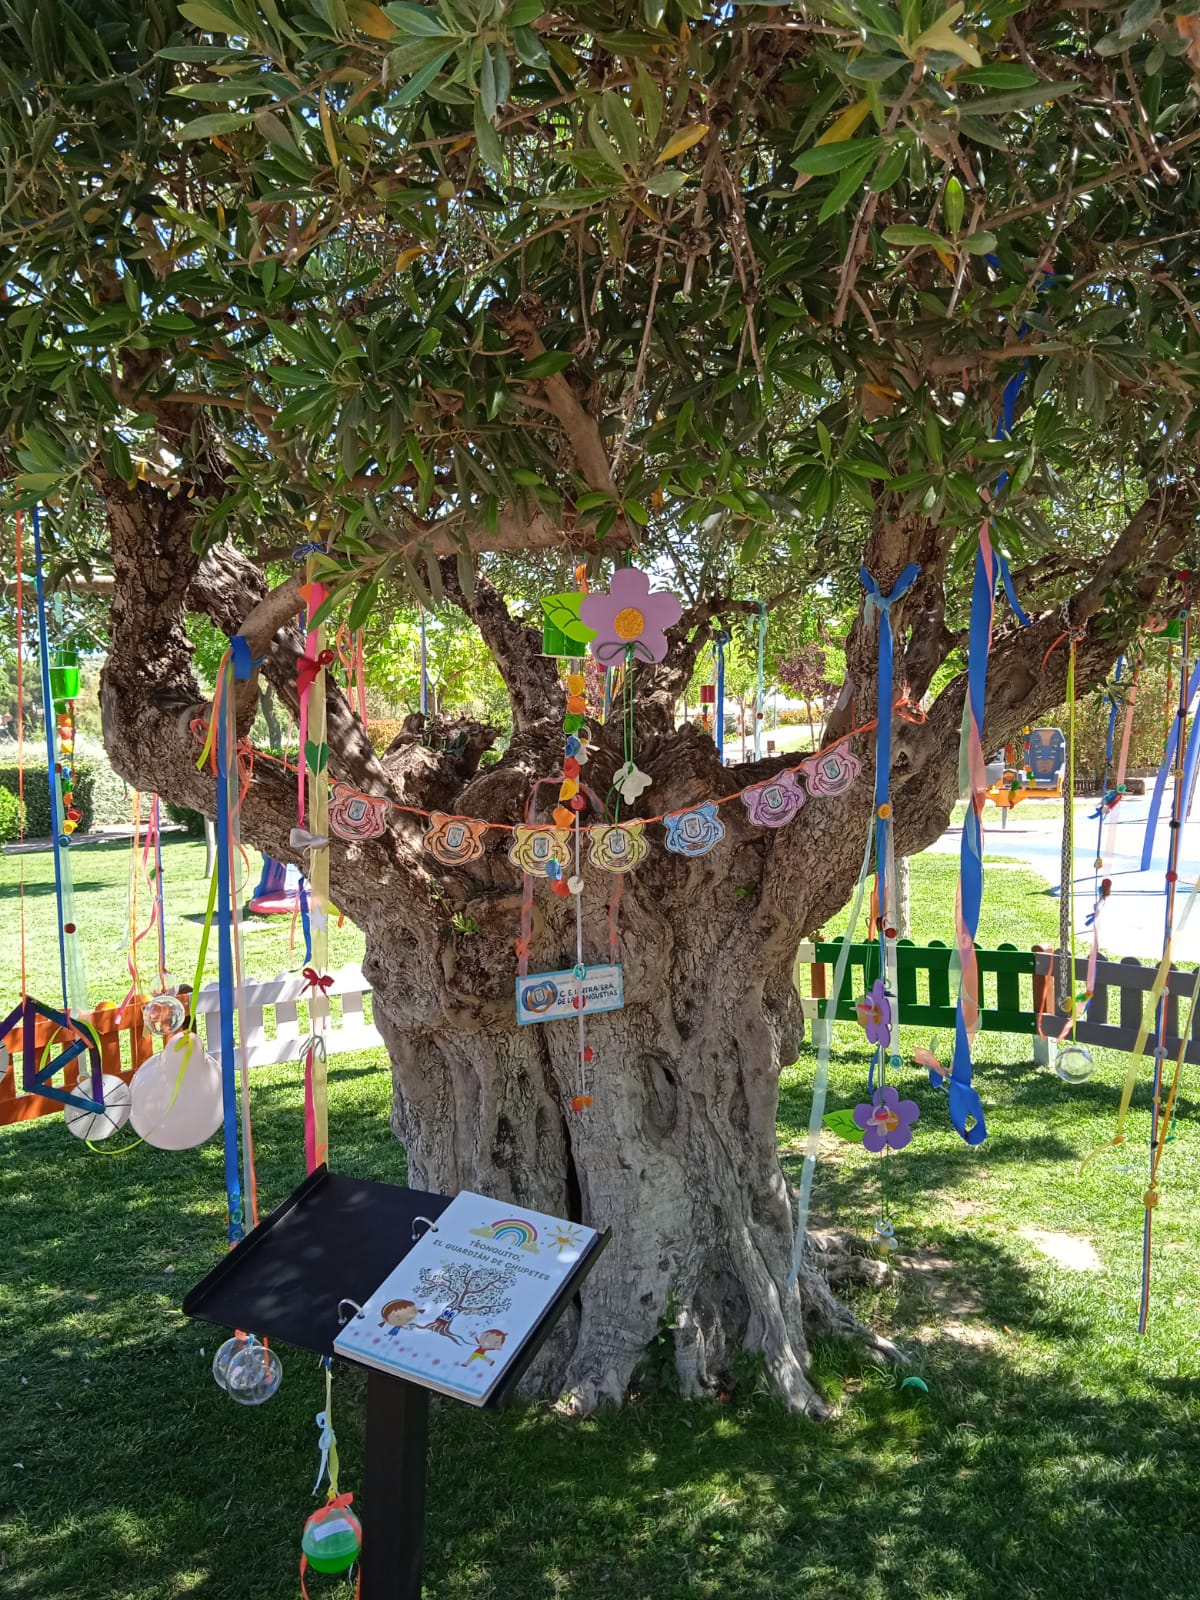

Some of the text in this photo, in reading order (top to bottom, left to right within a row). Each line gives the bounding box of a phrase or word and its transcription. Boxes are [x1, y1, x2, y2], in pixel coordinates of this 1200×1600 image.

[584, 989, 618, 1000] NGUSTIAS
[432, 1239, 551, 1281] EL GUARDIÁN DE CHUPETES
[469, 1240, 521, 1262] TRONQUITO,
